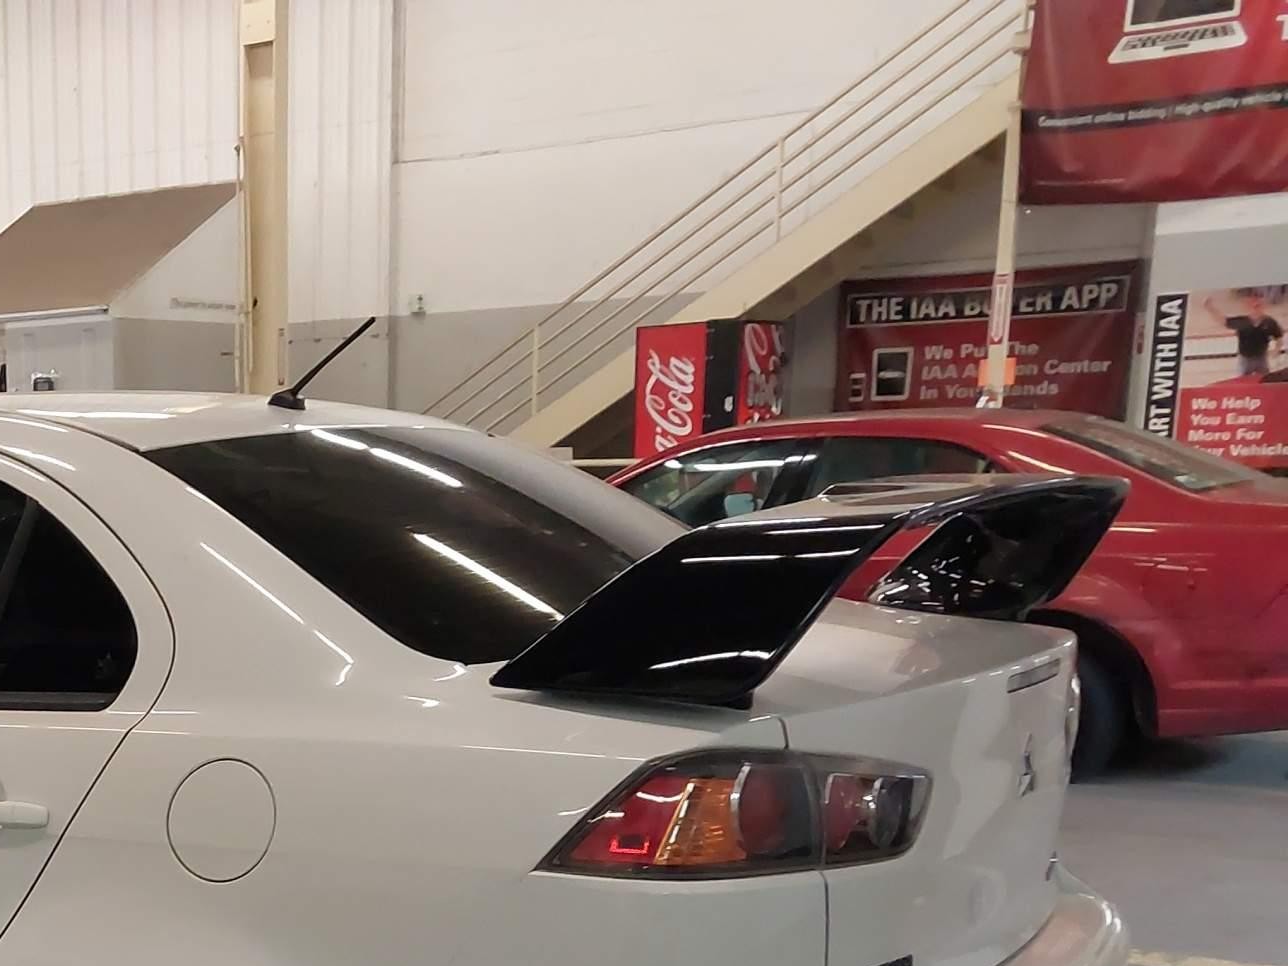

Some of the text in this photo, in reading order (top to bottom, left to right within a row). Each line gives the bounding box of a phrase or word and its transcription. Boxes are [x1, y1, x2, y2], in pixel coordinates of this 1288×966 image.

[855, 297, 904, 322] THE
[910, 296, 956, 319] IAA
[1059, 283, 1118, 310] APP
[1158, 298, 1184, 338] IAA
[924, 345, 954, 360] We
[921, 362, 958, 381] IAA
[1043, 359, 1113, 375] Center
[1152, 343, 1178, 401] WITH
[919, 385, 939, 400] In
[1191, 396, 1262, 412] We Help
[1190, 412, 1265, 426] You Earn
[1188, 428, 1264, 442] More For
